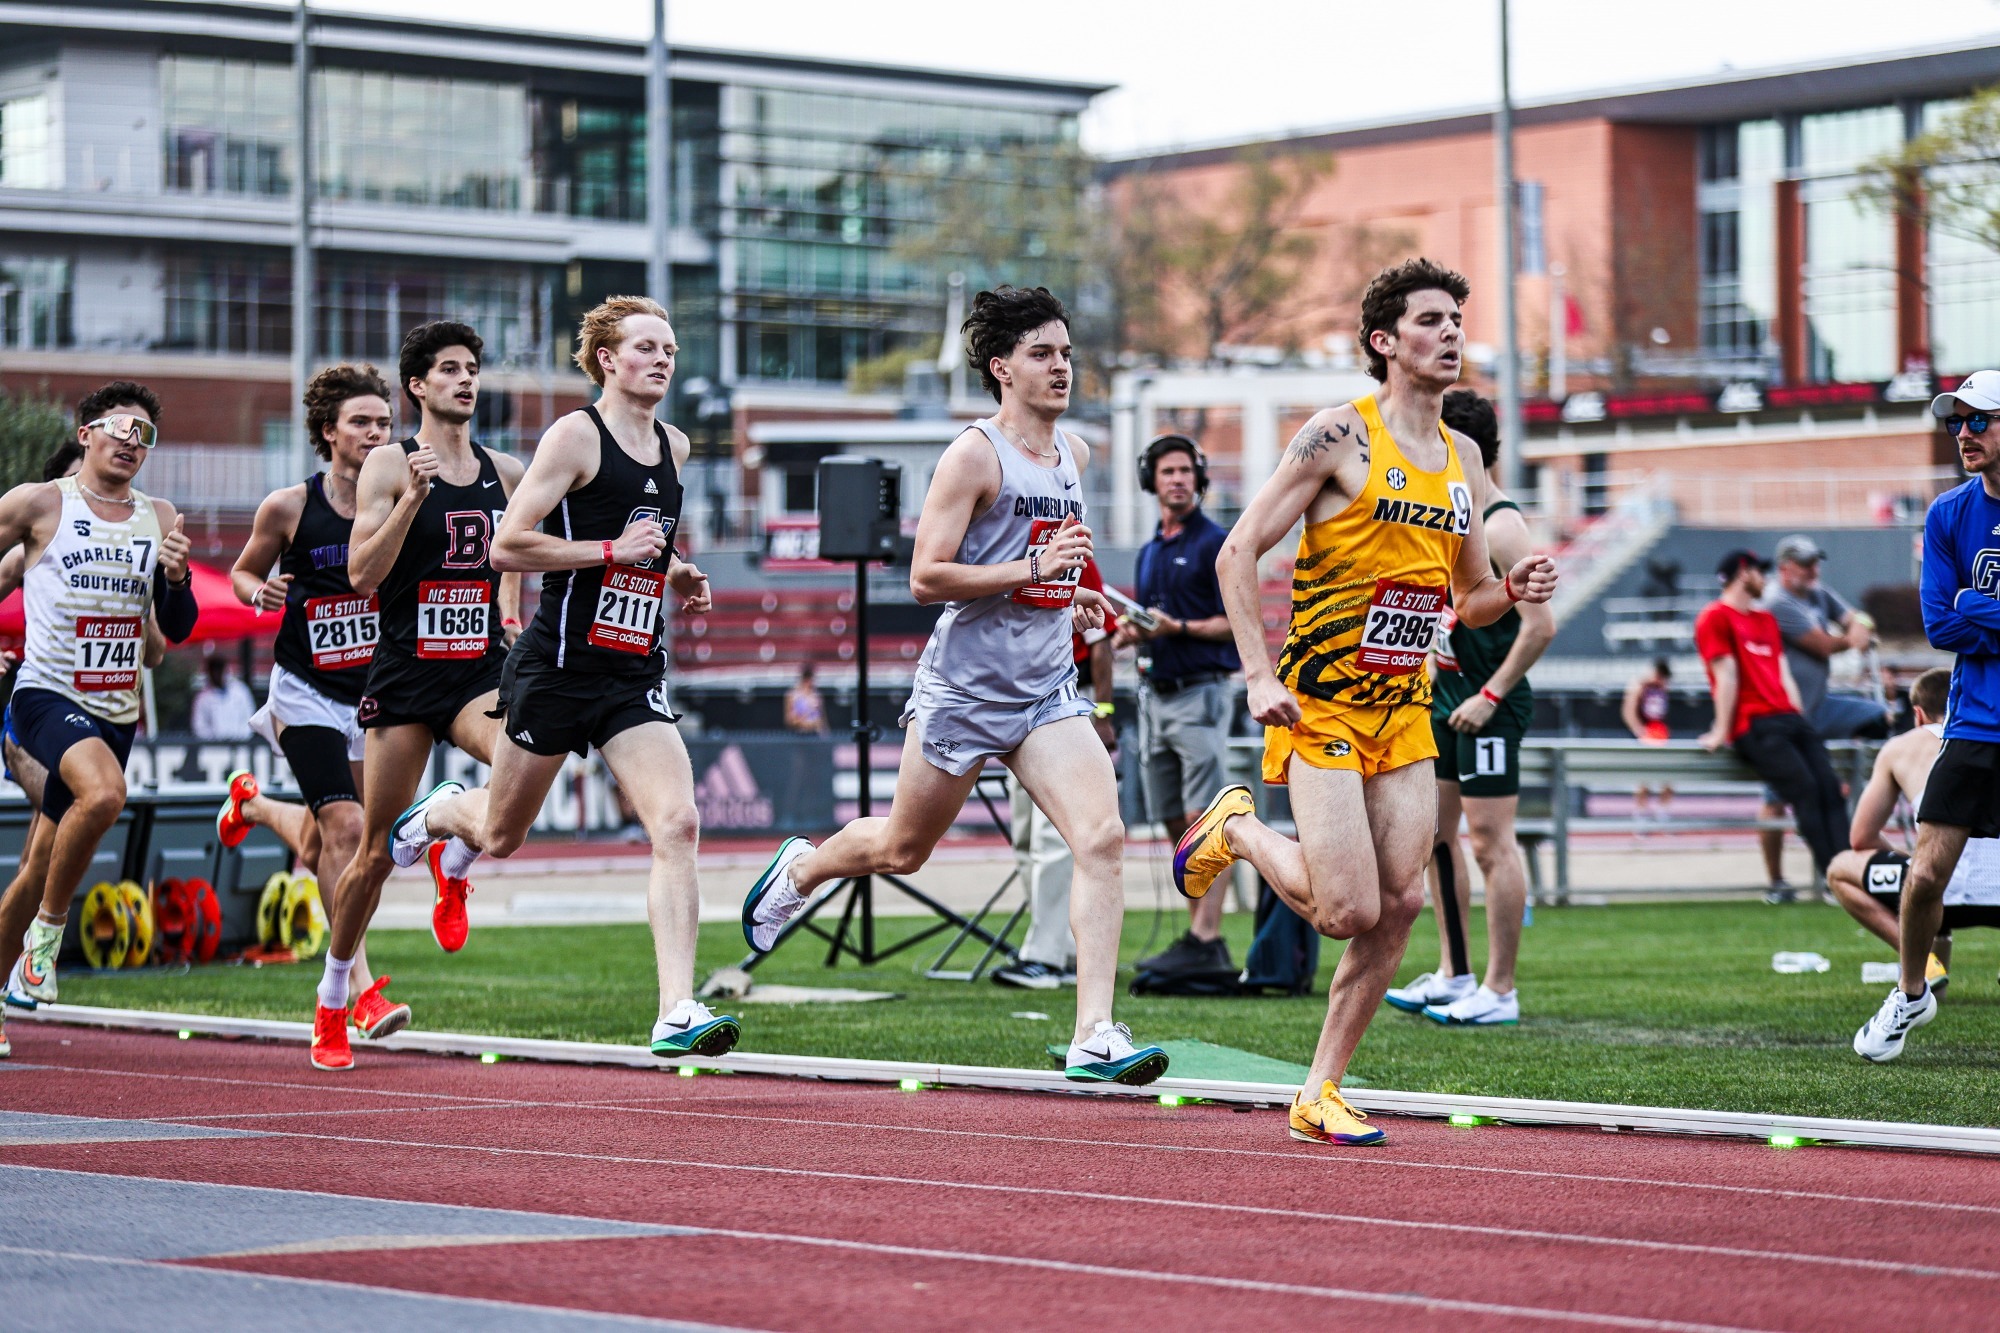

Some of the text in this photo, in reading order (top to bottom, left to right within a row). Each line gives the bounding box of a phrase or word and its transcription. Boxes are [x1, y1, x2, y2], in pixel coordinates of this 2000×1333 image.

[1386, 467, 1406, 490] SEC
[1453, 486, 1471, 530] 9
[62, 547, 133, 570] CHARLES
[132, 540, 152, 573] 7
[70, 574, 148, 597] SOUTHERN
[610, 572, 629, 588] NC
[628, 576, 659, 595] STATE
[427, 588, 484, 603] NC STATE
[1380, 589, 1441, 611] NC STATE
[315, 599, 370, 619] NC STATE
[598, 591, 654, 630] 2111
[84, 623, 137, 637] NC STATE
[312, 615, 377, 650] 2815
[423, 607, 484, 636] 1636
[1366, 610, 1438, 650] 2395
[450, 639, 485, 651] adidas
[618, 632, 650, 647] adidas
[81, 641, 136, 668] 1744
[104, 672, 134, 684] adidas
[1481, 741, 1496, 771] 1
[1872, 869, 1898, 887] 3
